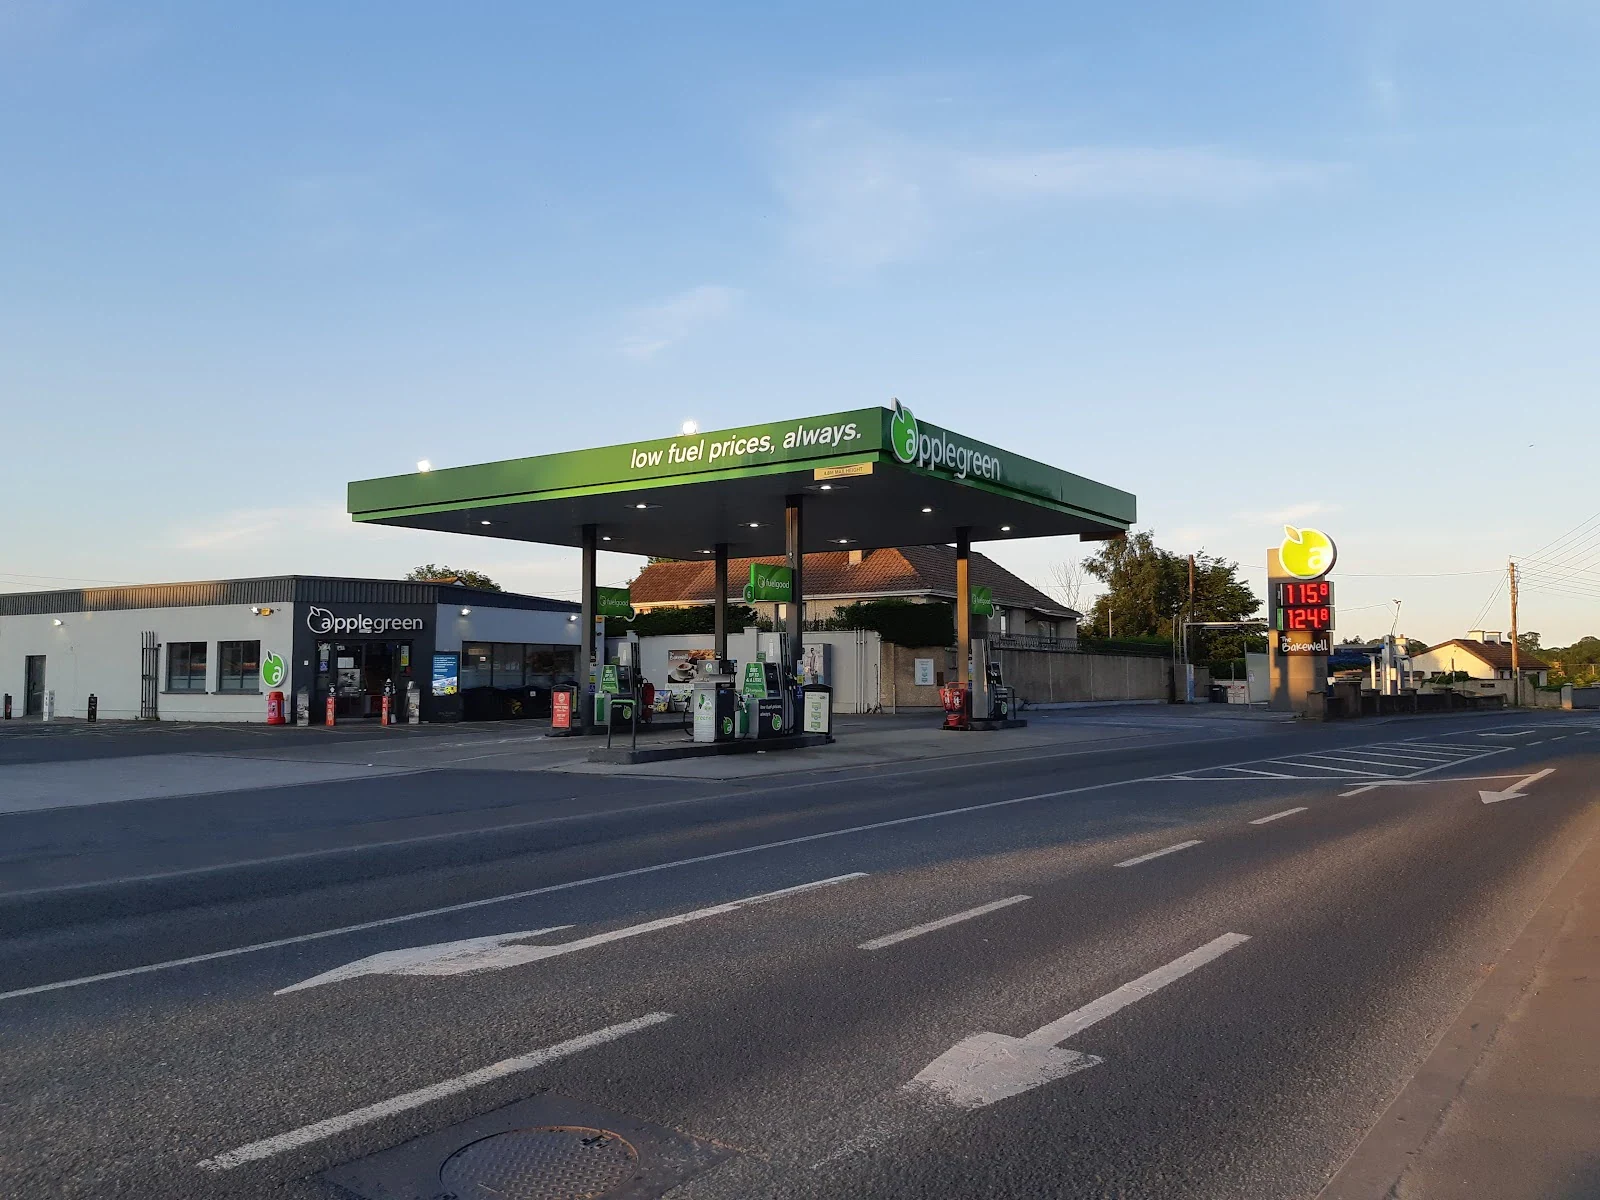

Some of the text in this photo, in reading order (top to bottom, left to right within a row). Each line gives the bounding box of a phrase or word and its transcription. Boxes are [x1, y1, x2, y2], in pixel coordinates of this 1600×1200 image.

[630, 422, 862, 469] low fuel prices, always.
[905, 428, 1001, 481] applegreen
[845, 466, 864, 474] HEIGHT
[765, 578, 790, 589] fuelgood
[606, 598, 629, 608] fuelgood
[321, 613, 423, 634] applegreen
[1280, 635, 1292, 643] The
[1281, 639, 1328, 653] Bakewell
[272, 665, 282, 682] a
